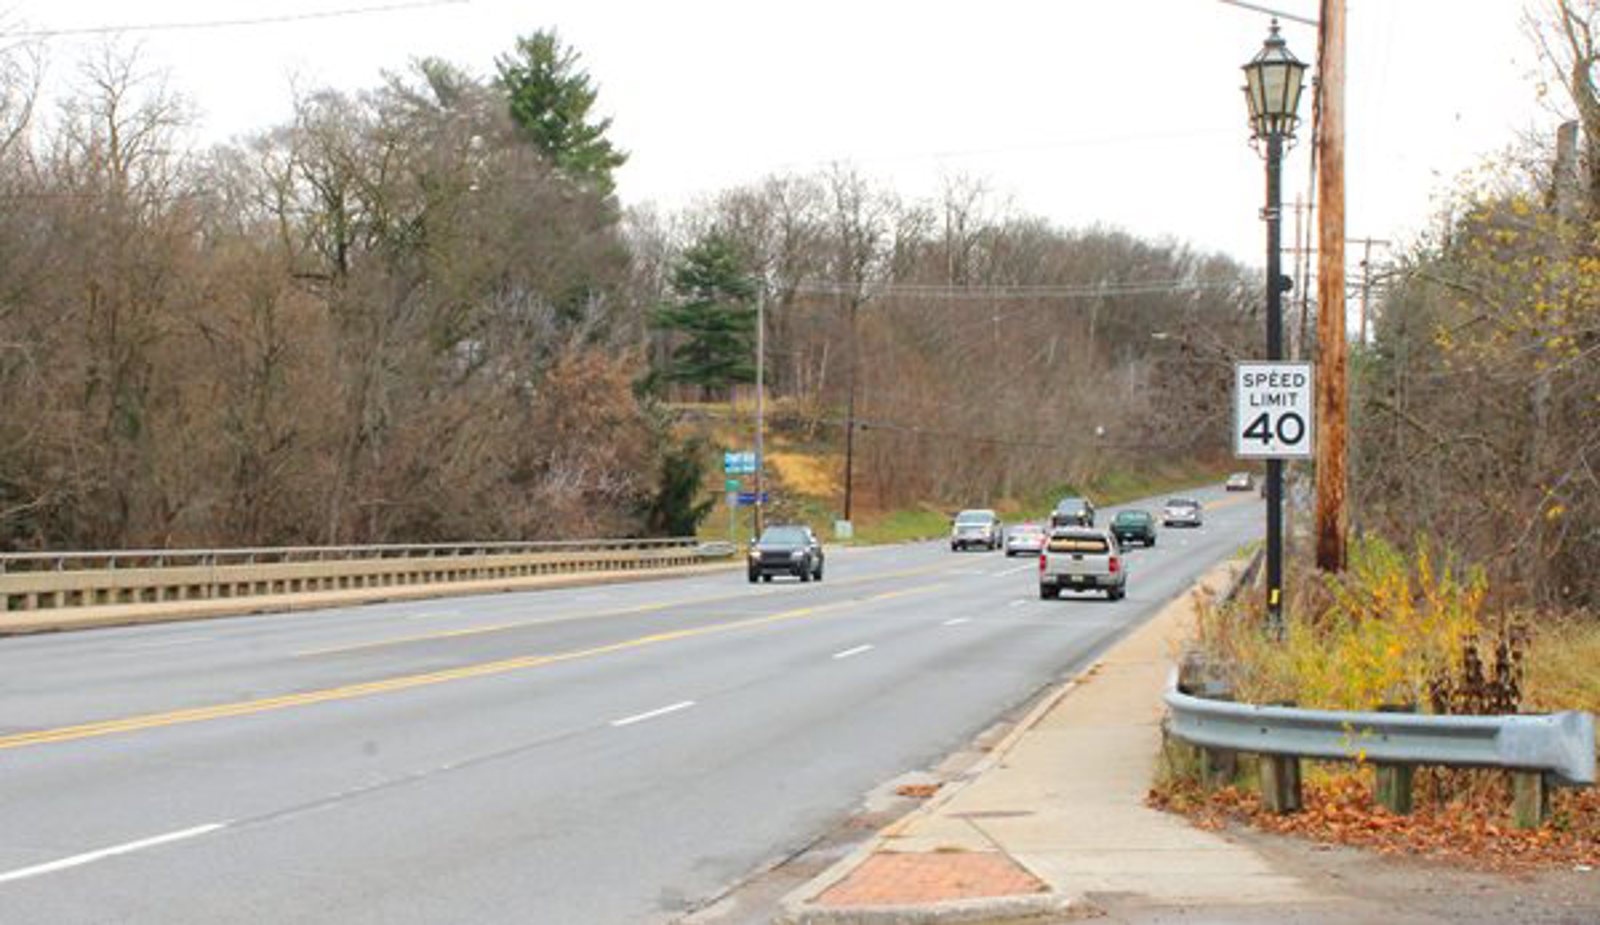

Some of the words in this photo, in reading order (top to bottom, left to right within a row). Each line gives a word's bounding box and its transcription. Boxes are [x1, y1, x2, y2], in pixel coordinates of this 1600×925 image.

[1243, 373, 1305, 387] SPEED
[1250, 392, 1298, 406] LIMIT
[1242, 412, 1305, 445] 40
